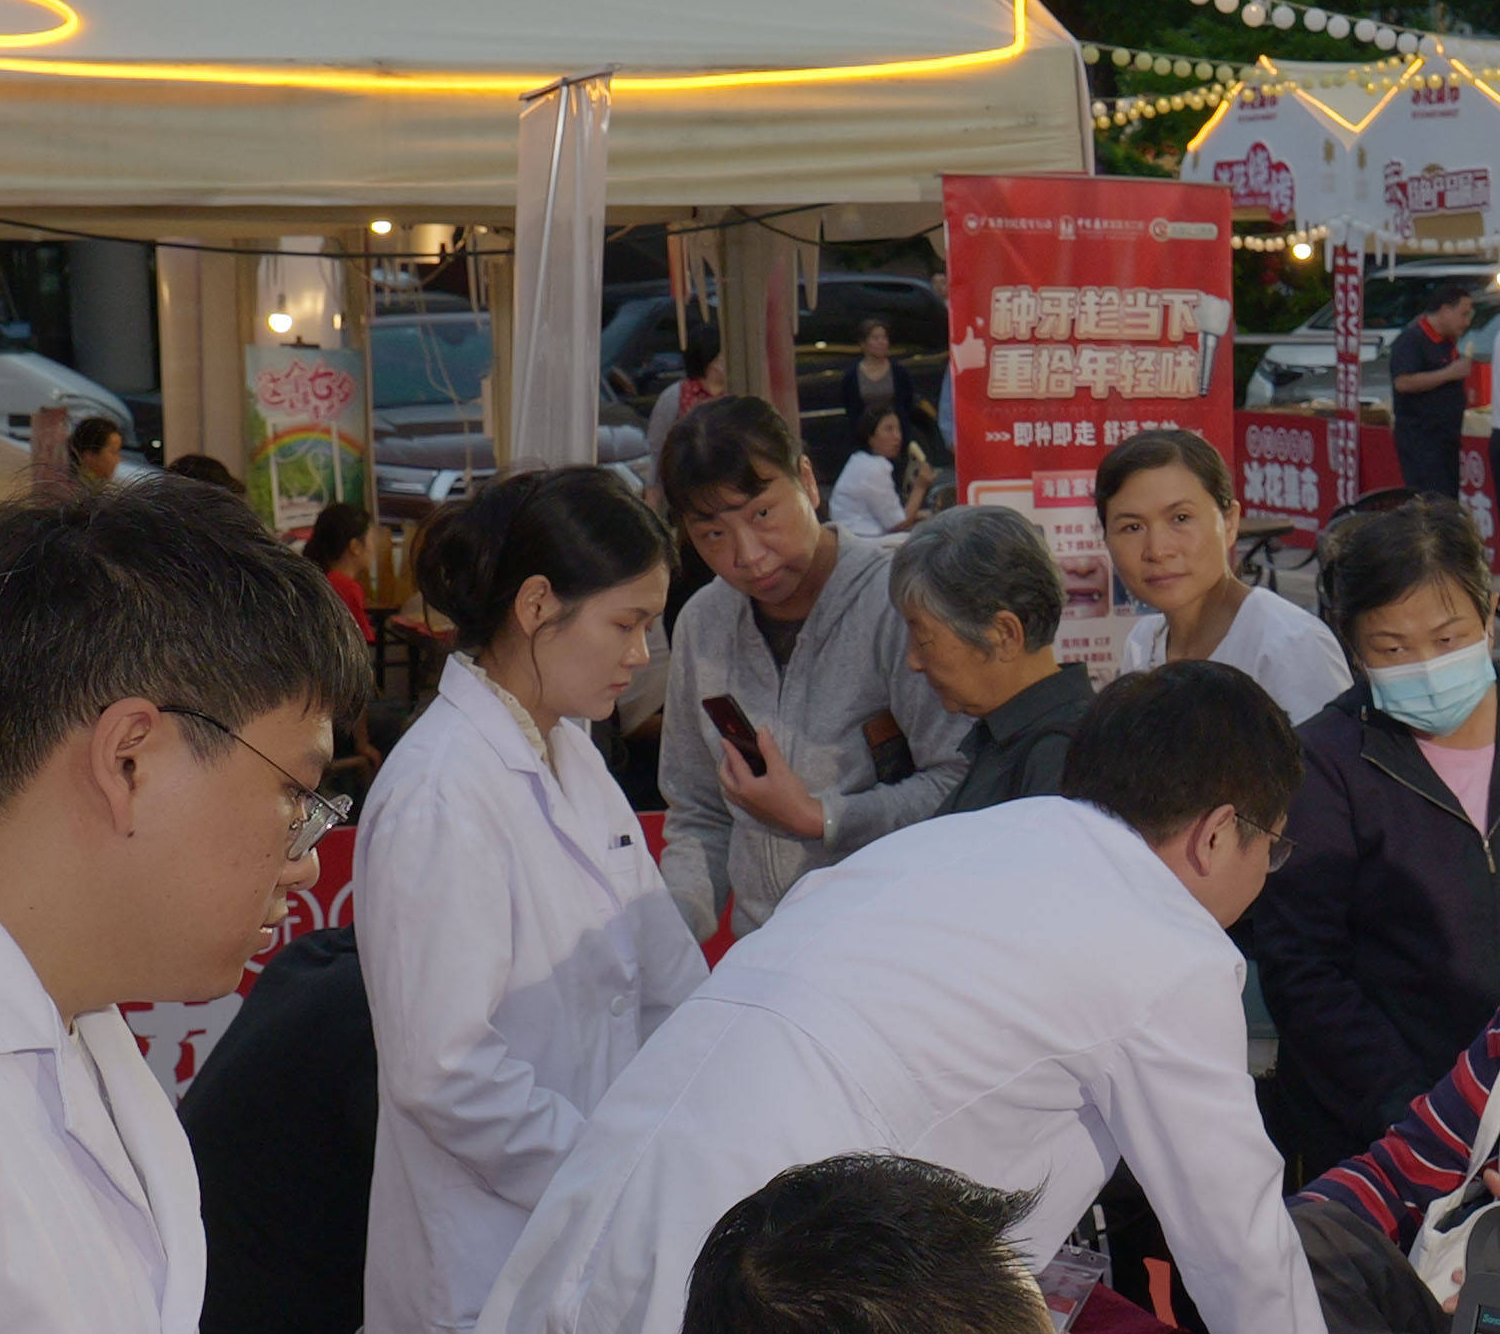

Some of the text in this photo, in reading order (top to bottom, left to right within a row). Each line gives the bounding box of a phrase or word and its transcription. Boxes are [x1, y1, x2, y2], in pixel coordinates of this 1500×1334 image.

[987, 344, 1200, 400] 重拾年轻味
[1013, 420, 1097, 447] 即种即走
